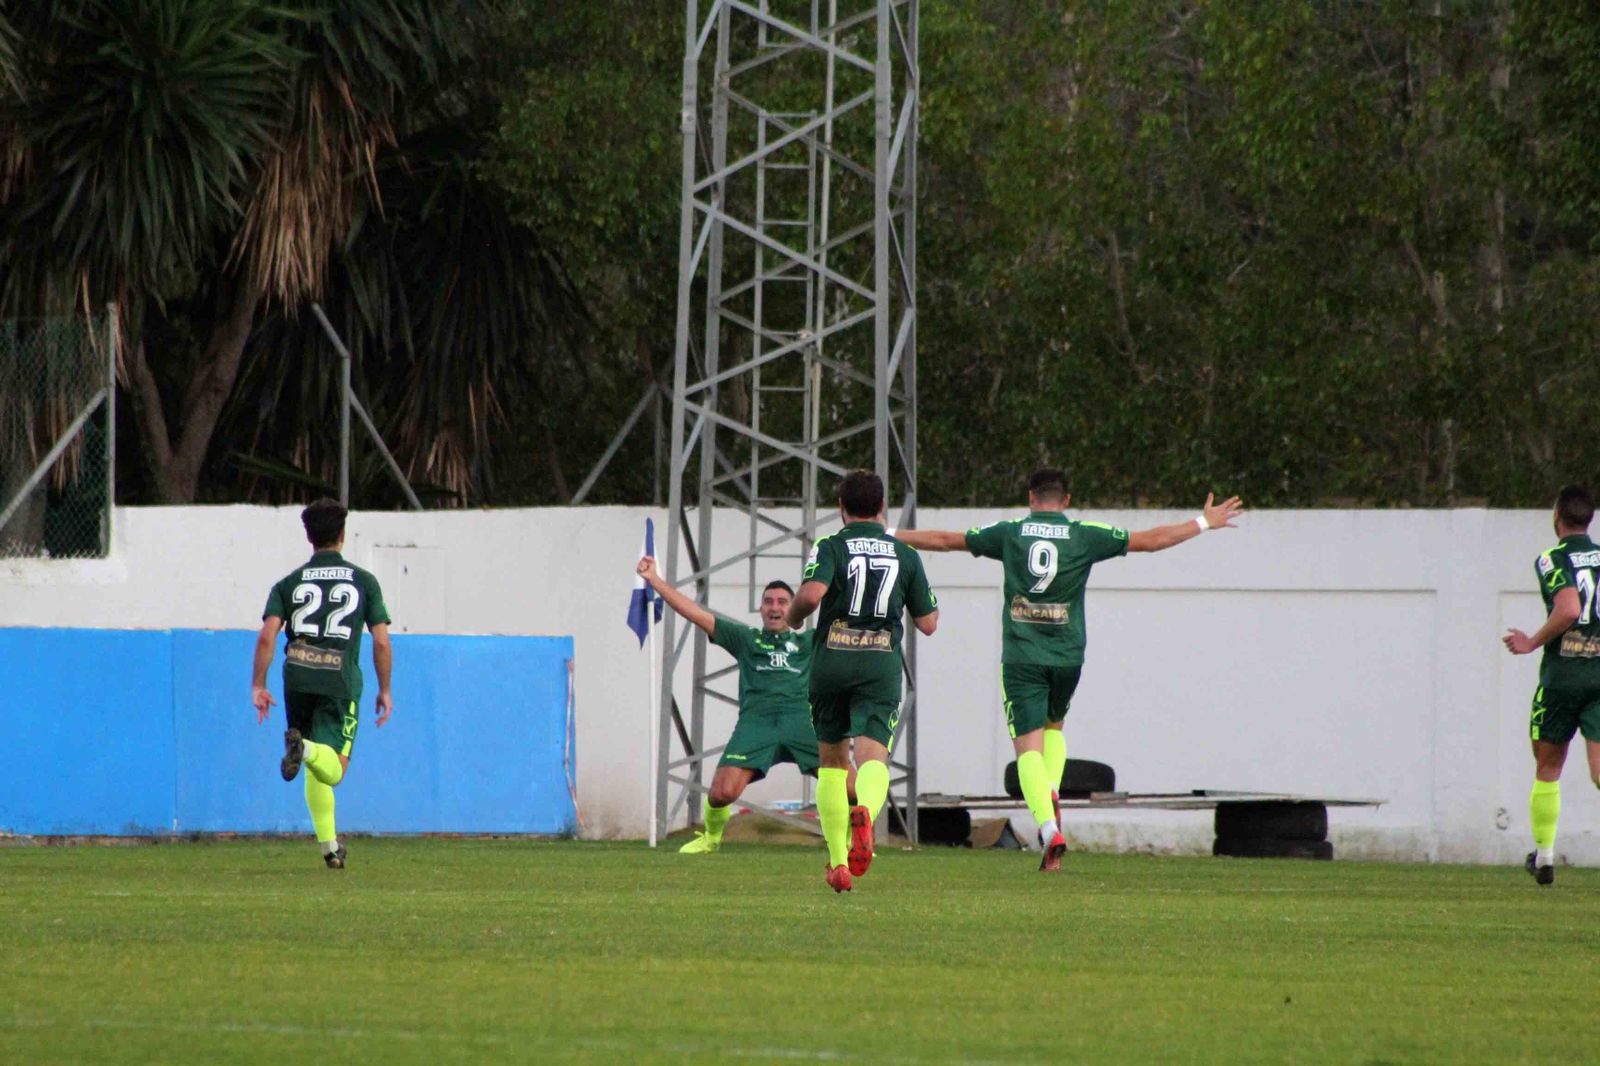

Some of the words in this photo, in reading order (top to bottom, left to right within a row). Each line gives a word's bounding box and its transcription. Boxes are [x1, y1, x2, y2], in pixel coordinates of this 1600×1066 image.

[846, 540, 896, 556] RANABE
[1028, 540, 1058, 593] 9
[291, 583, 359, 640] 22
[847, 556, 899, 617] 17
[1575, 568, 1600, 624] 1
